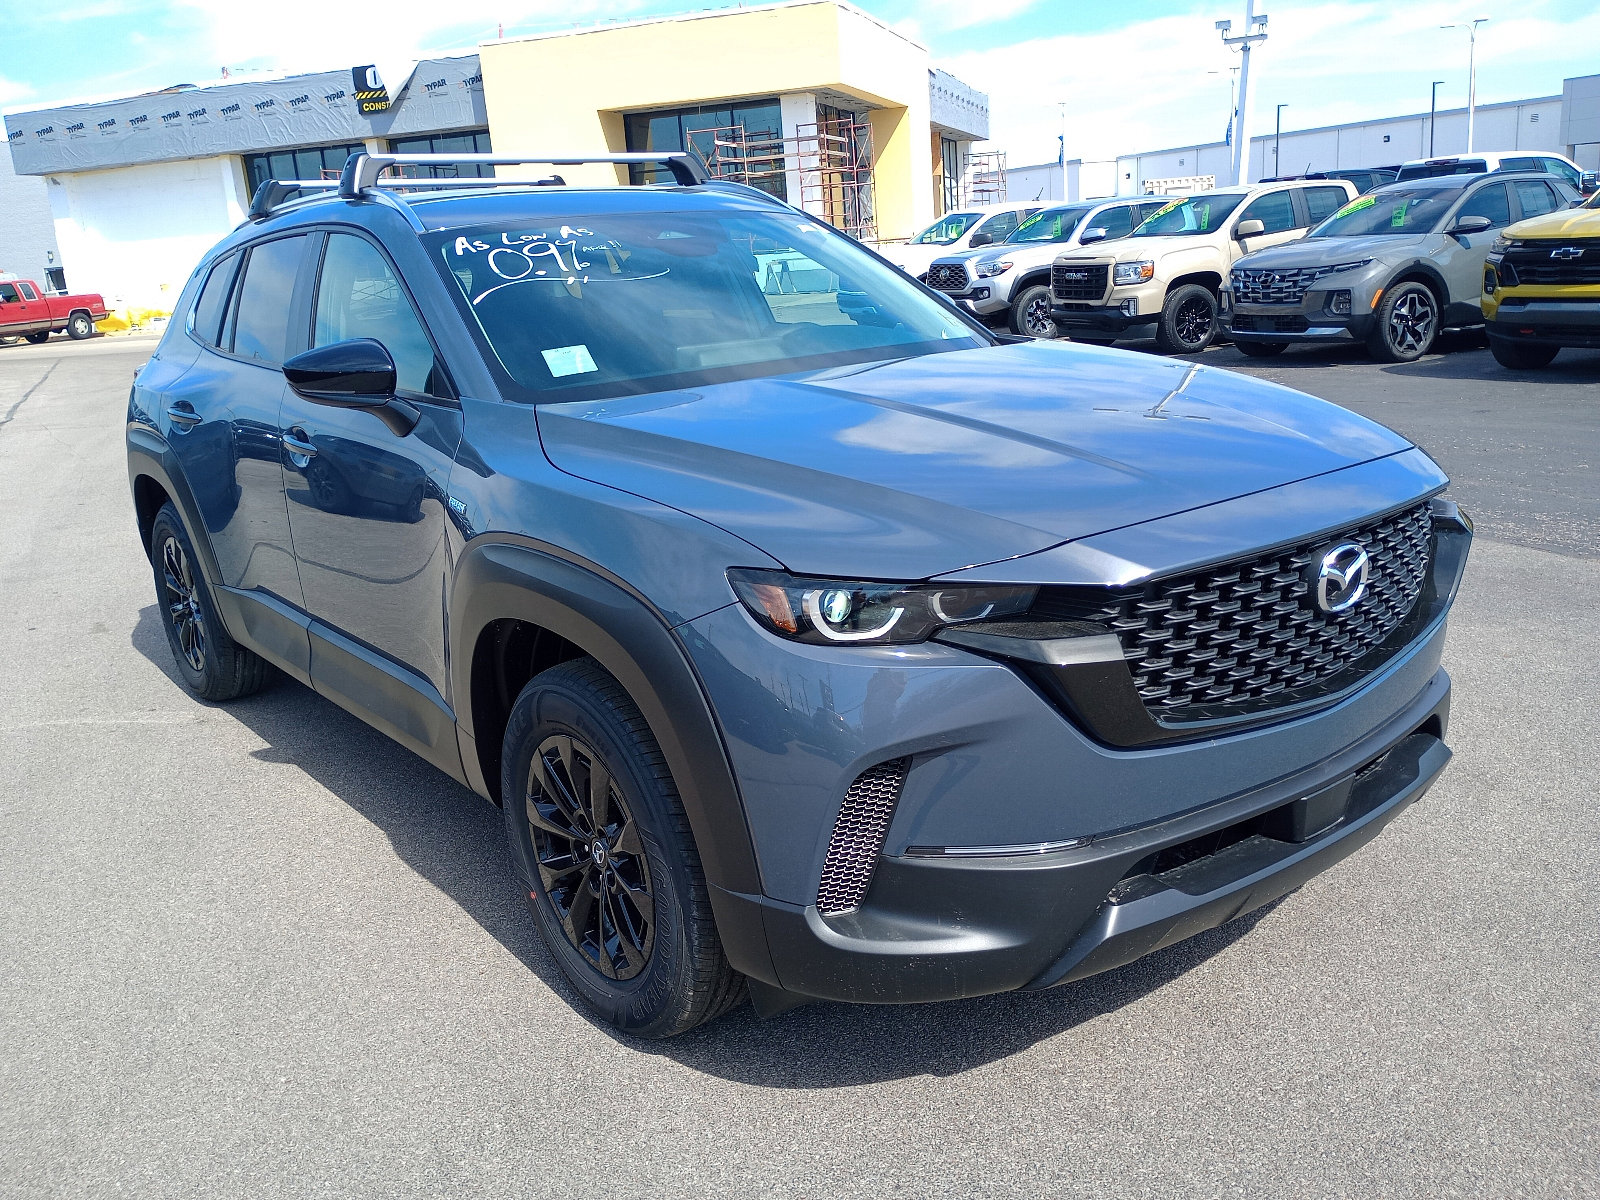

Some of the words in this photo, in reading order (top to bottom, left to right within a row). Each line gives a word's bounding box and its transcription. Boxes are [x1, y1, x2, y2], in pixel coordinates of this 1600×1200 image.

[425, 79, 447, 91] TYPAR
[289, 95, 309, 107] TYPAR
[325, 90, 345, 103] TYPAR
[221, 103, 240, 116] TYPAR
[255, 99, 275, 111] TYPAR
[161, 110, 181, 122] TYPAR
[187, 108, 207, 120] TYPAR
[98, 118, 116, 130] TYPAR
[129, 115, 148, 126] TYPAR
[36, 126, 54, 138] TYPAR
[66, 122, 85, 134] TYPAR
